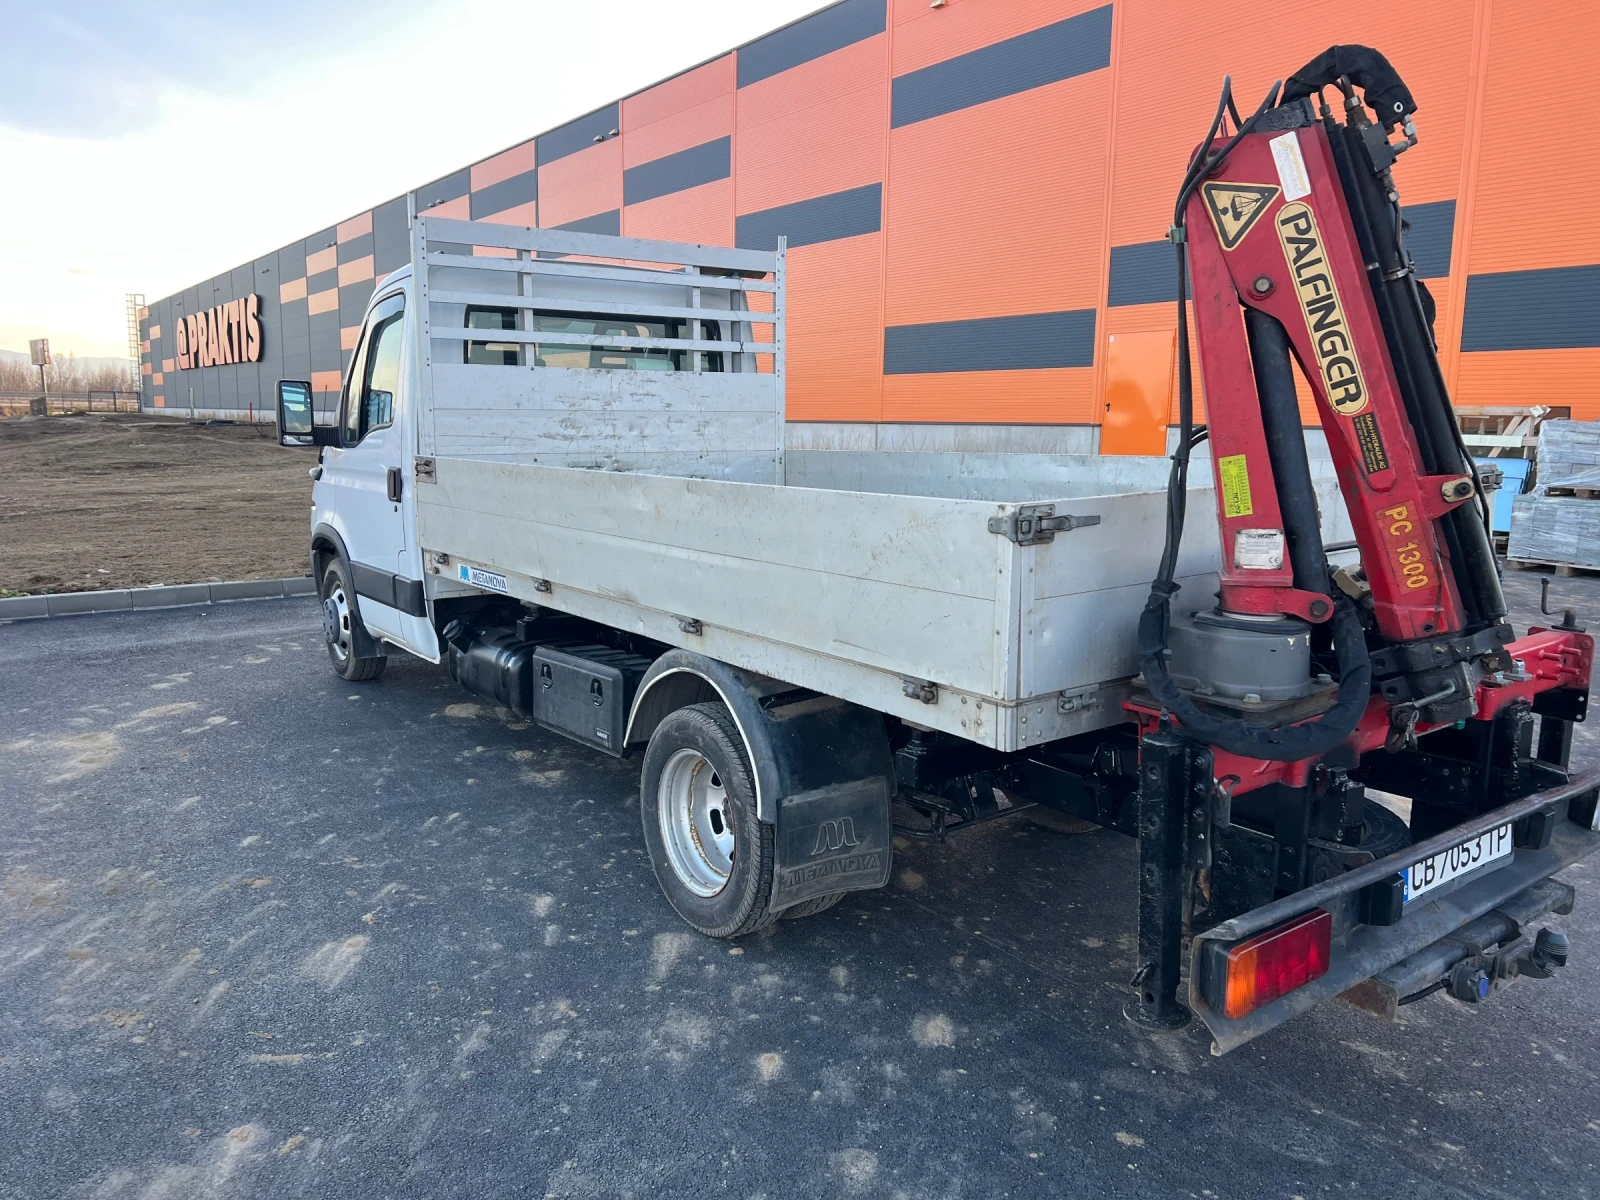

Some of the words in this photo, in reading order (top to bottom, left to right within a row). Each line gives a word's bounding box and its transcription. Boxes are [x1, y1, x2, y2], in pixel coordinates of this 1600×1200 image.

[1280, 210, 1362, 407] PALFINGER
[1384, 505, 1413, 536] PC
[1396, 541, 1429, 588] 1300
